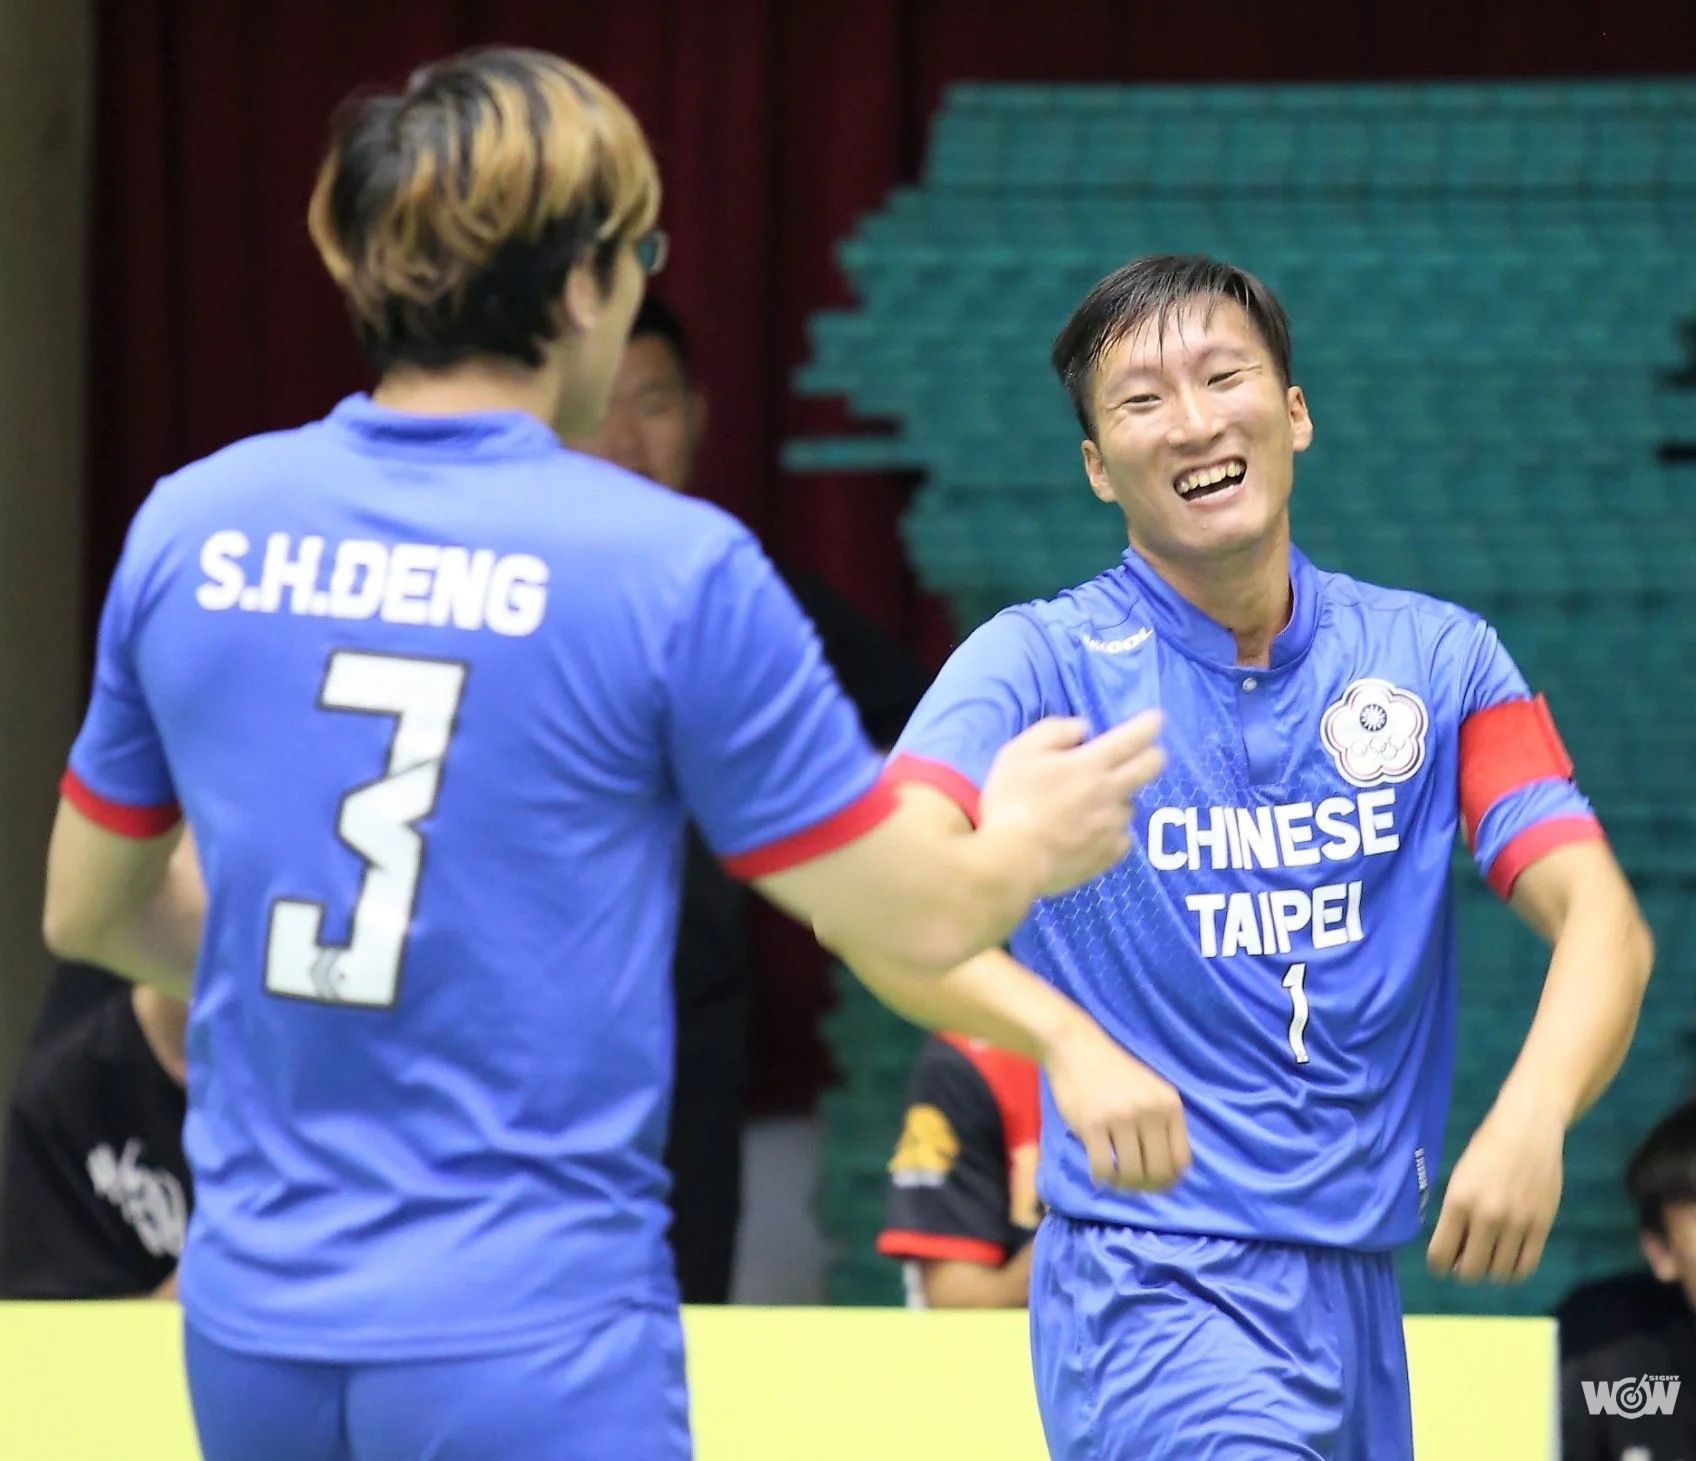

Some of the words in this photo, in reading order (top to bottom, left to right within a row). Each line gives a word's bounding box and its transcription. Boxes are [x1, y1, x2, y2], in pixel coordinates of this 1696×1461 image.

[196, 530, 550, 637] S.H.DENG
[264, 647, 471, 1010] 3
[1147, 788, 1400, 871] CHINESE
[1184, 880, 1364, 958] TAIPEI
[1281, 962, 1309, 1064] 1
